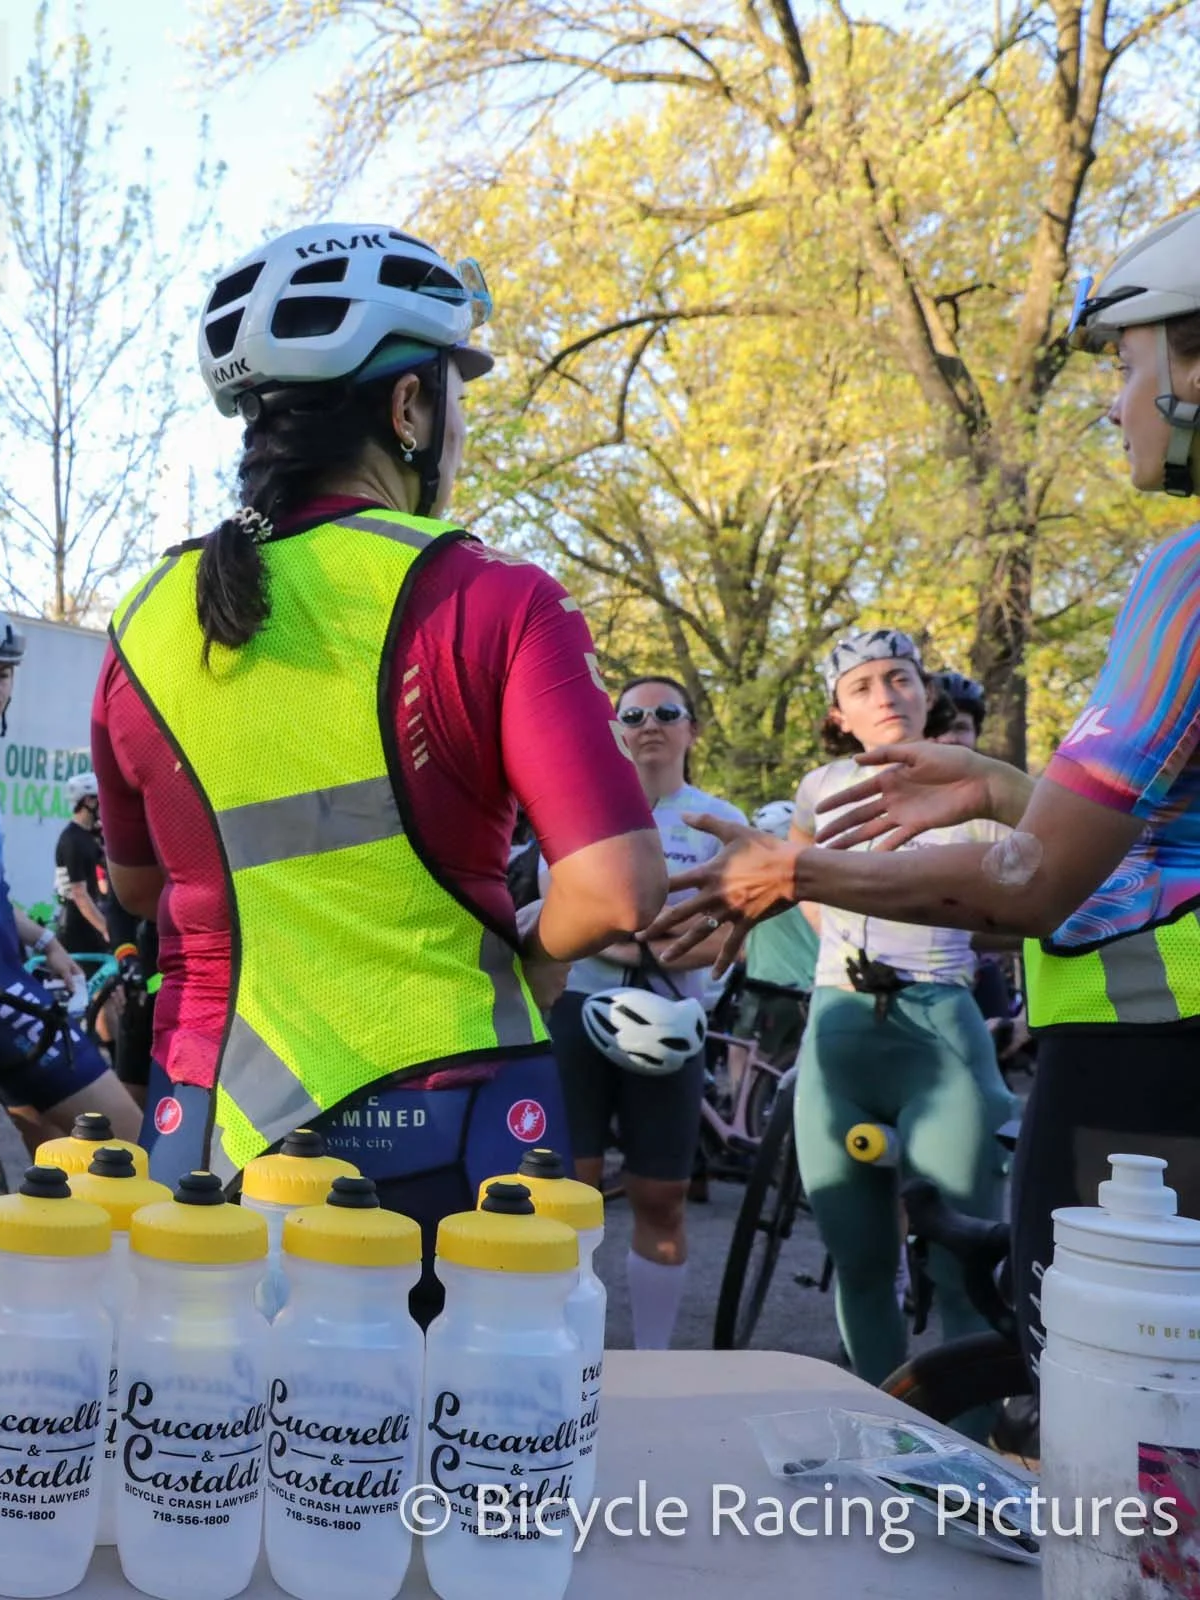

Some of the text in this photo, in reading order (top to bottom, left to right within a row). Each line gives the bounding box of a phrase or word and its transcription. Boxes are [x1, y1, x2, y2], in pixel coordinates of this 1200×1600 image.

[5, 743, 48, 780] OUR
[54, 750, 94, 782] EXP
[366, 1136, 394, 1151] city
[121, 1381, 267, 1440] Lucarelli
[268, 1378, 410, 1446] Lucarelli
[427, 1391, 578, 1454] Lucarelli
[27, 1444, 41, 1457] &
[201, 1450, 216, 1463] &
[330, 1453, 345, 1466] &
[124, 1434, 261, 1493] Castaldi
[268, 1430, 403, 1499] Castaldi
[510, 1463, 525, 1476] &
[41, 1487, 90, 1504] LAWYERS
[168, 1497, 211, 1509] CRASH
[216, 1489, 259, 1508] LAWYERS
[299, 1496, 340, 1513] CRASH
[345, 1501, 399, 1516] LAWYERS
[152, 1510, 230, 1525] 718-556-1800
[286, 1507, 361, 1531] 718-556-1800
